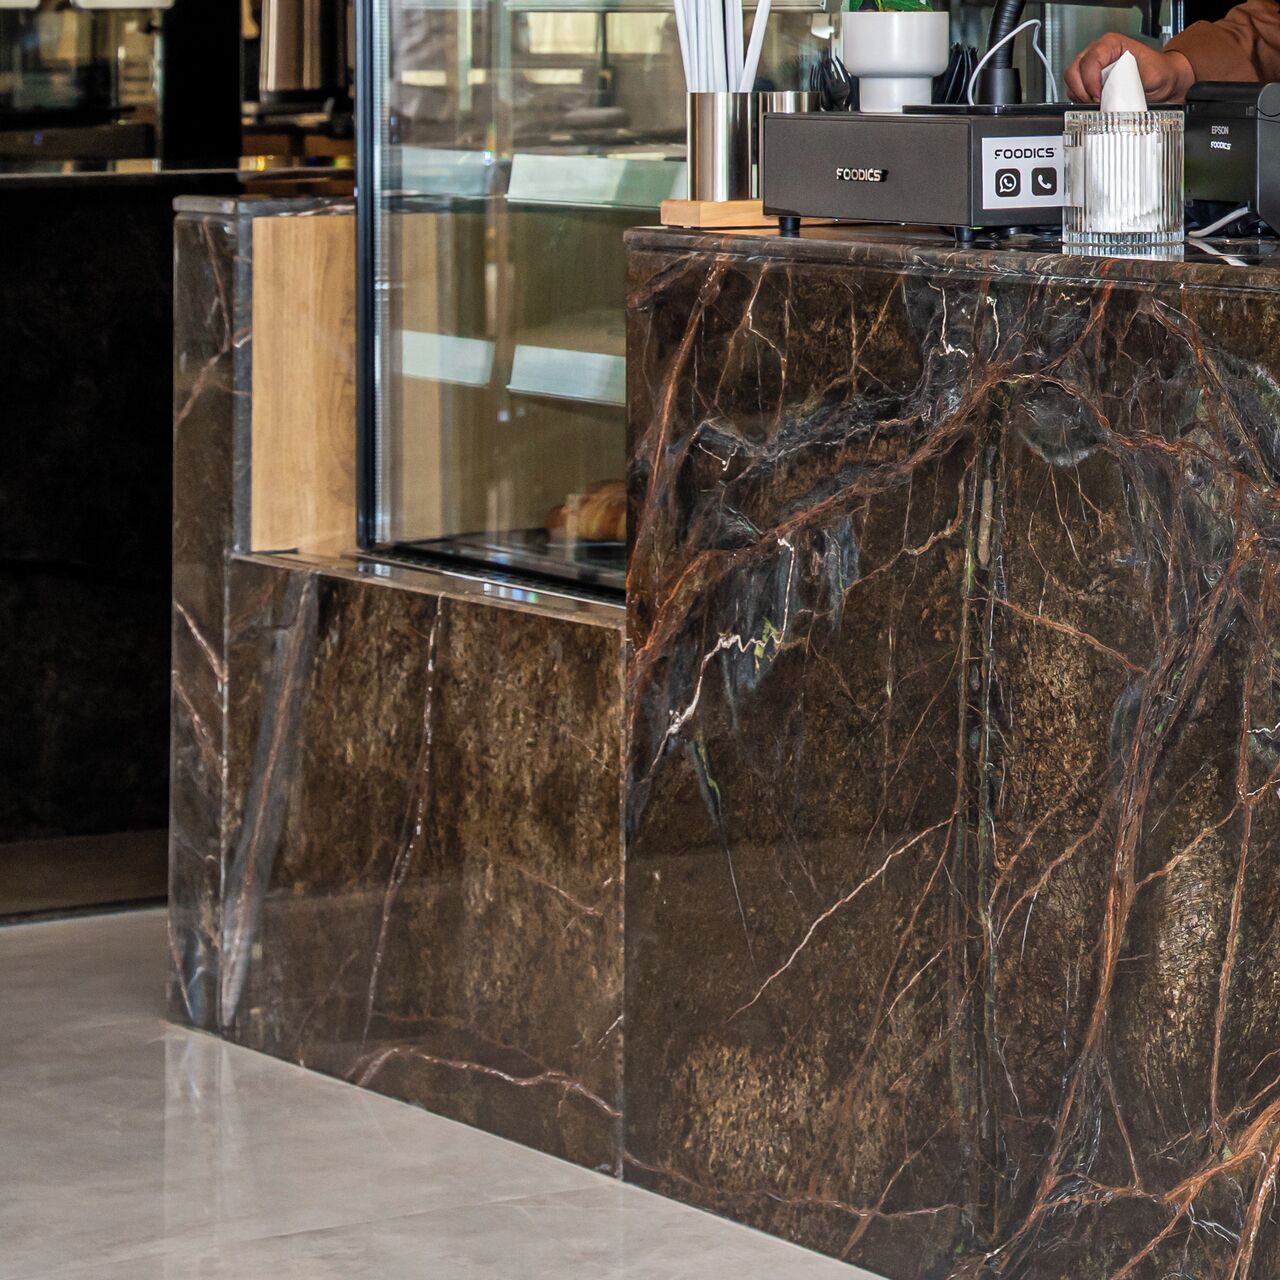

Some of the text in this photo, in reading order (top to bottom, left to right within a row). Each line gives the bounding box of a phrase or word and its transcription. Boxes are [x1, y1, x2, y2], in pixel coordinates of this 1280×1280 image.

[1211, 125, 1229, 135] EPSON
[1210, 140, 1232, 151] FOODICS
[994, 147, 1055, 160] FOODICS
[836, 167, 883, 182] FOODICS
